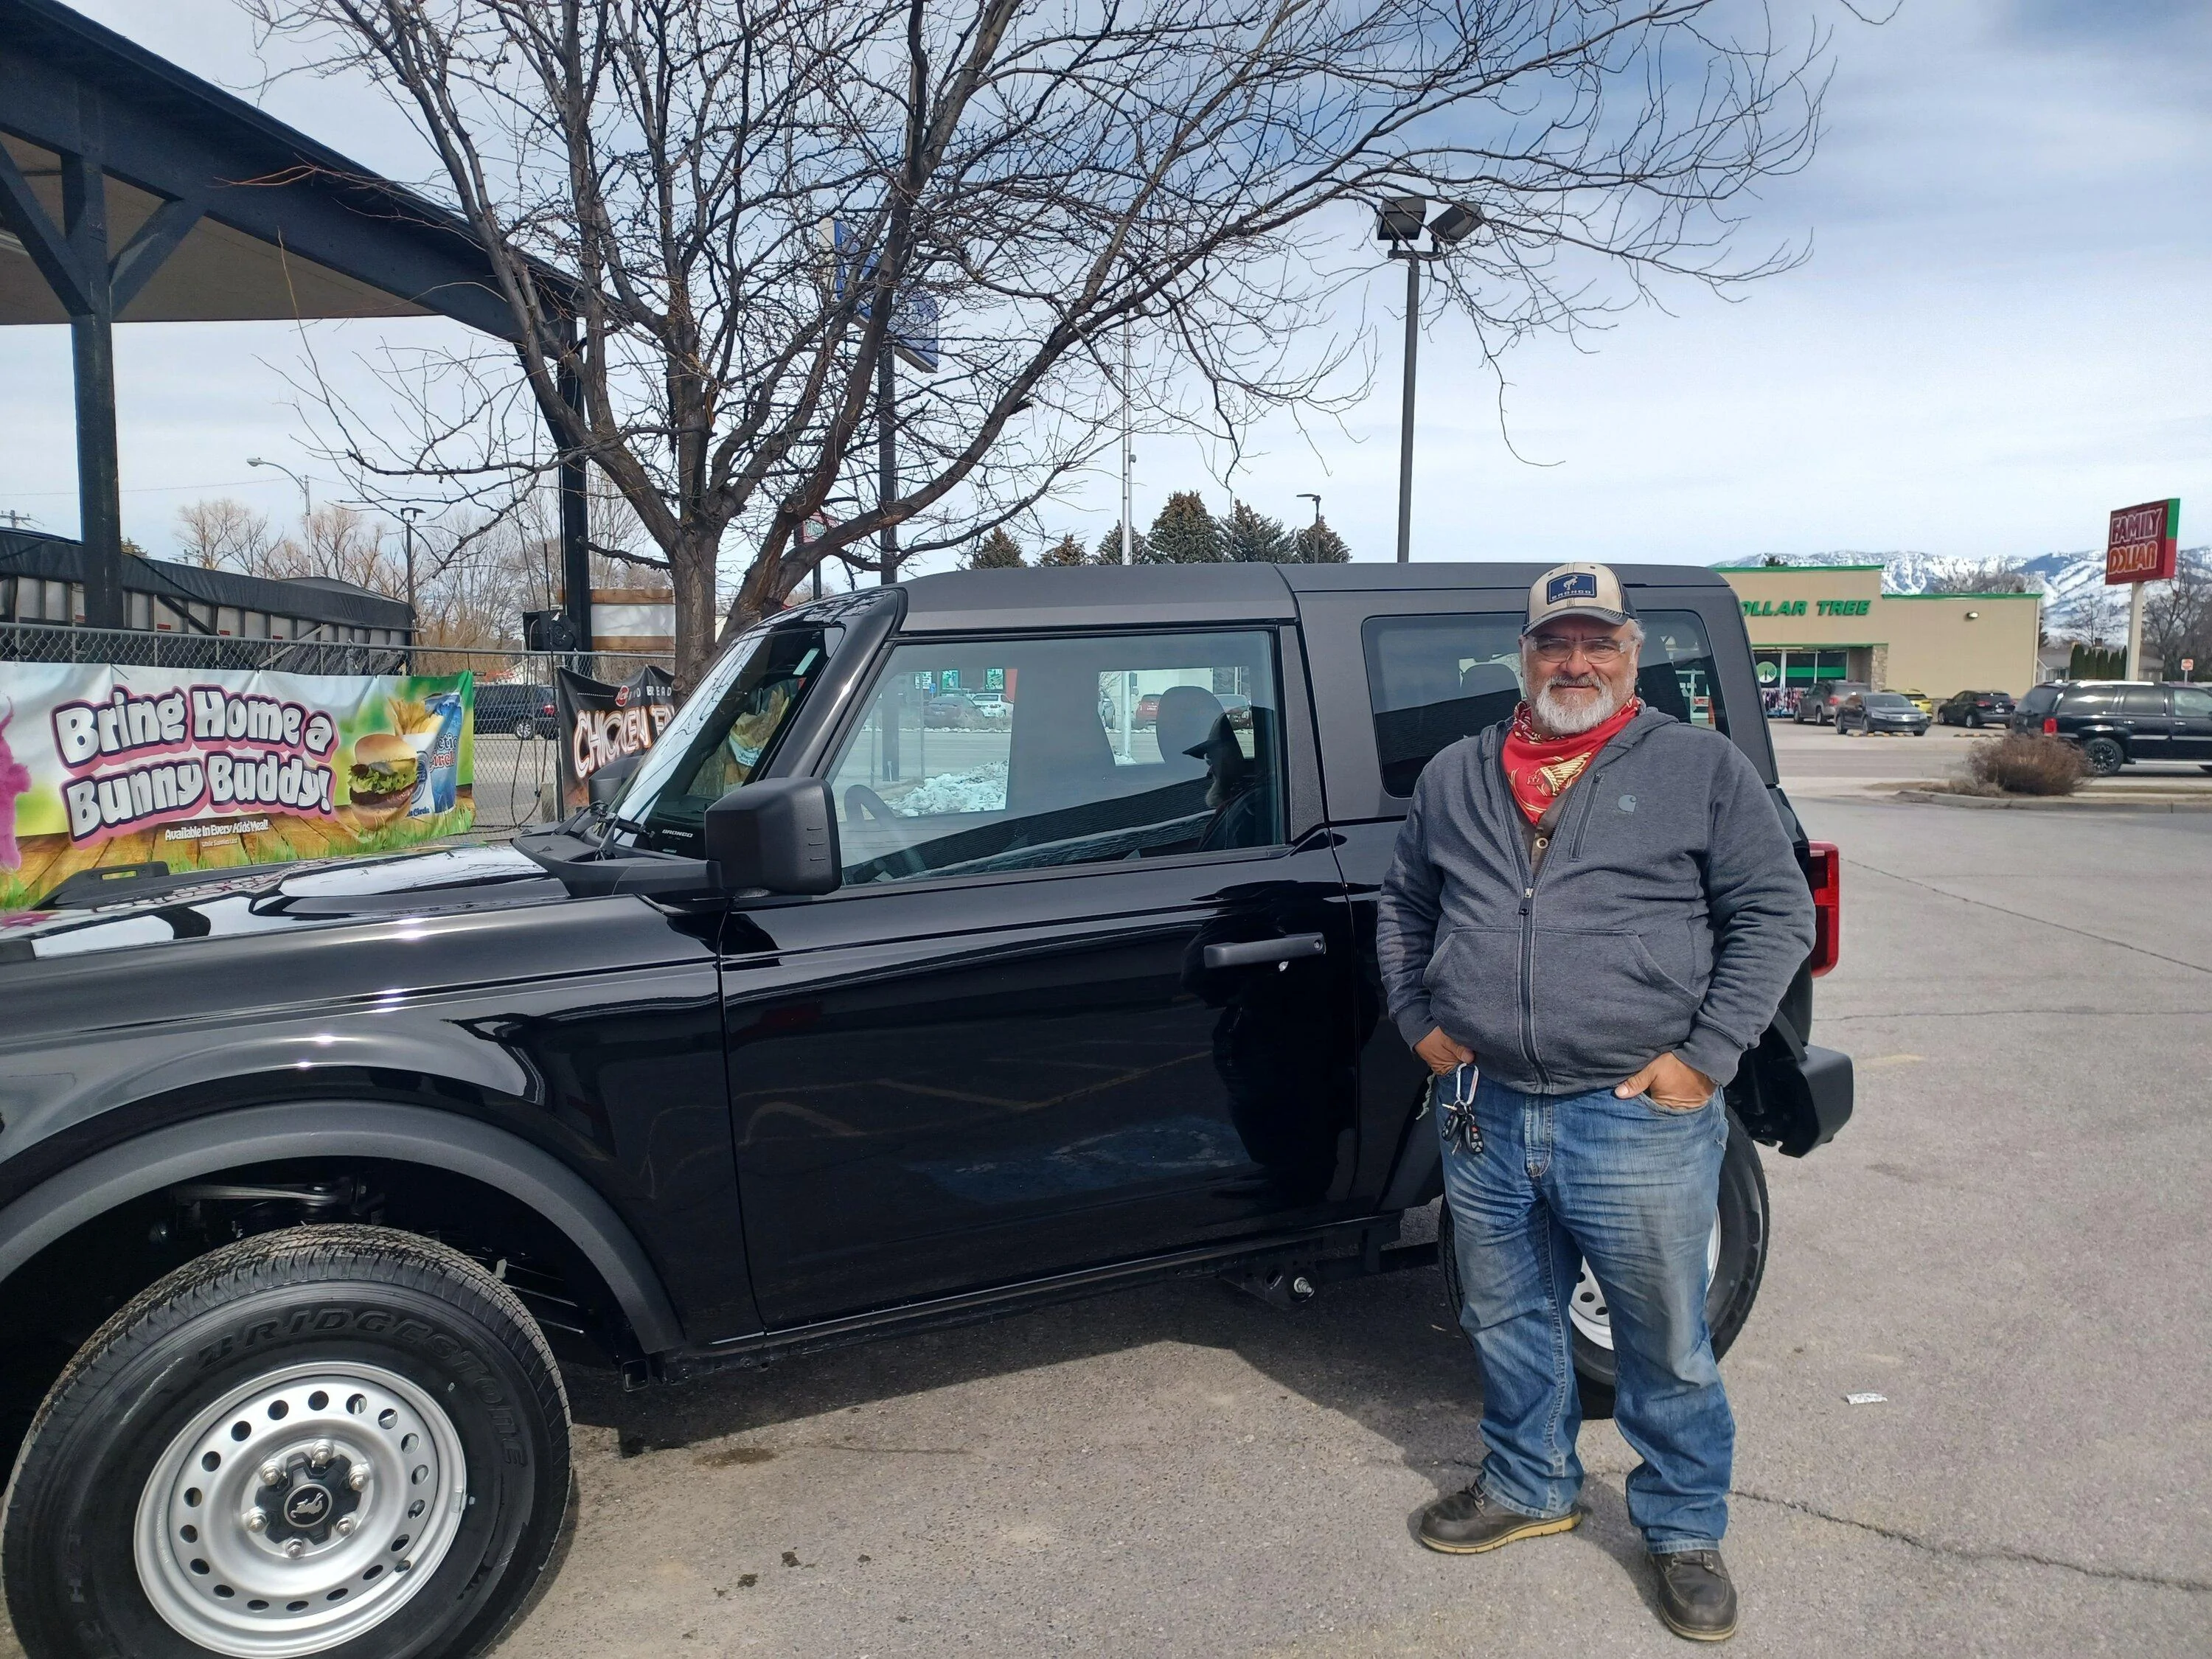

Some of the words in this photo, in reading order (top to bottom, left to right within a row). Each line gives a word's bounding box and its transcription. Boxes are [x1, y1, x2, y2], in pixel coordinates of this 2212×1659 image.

[2111, 507, 2163, 546] FAMILY
[2108, 540, 2158, 575] DOLLAR
[1551, 589, 1591, 599] BRONCO
[1739, 600, 1808, 616] OLLAR
[1817, 600, 1871, 616] TREE
[55, 691, 186, 764] Bring
[192, 690, 302, 746] Home
[305, 715, 333, 753] a
[67, 763, 204, 837] Bunny
[208, 754, 330, 813] Buddy!
[165, 826, 202, 841] Available
[202, 825, 211, 837] In
[211, 824, 233, 836] Every
[251, 818, 268, 832] Meal!
[193, 1307, 528, 1469] BRIDGESTONE
